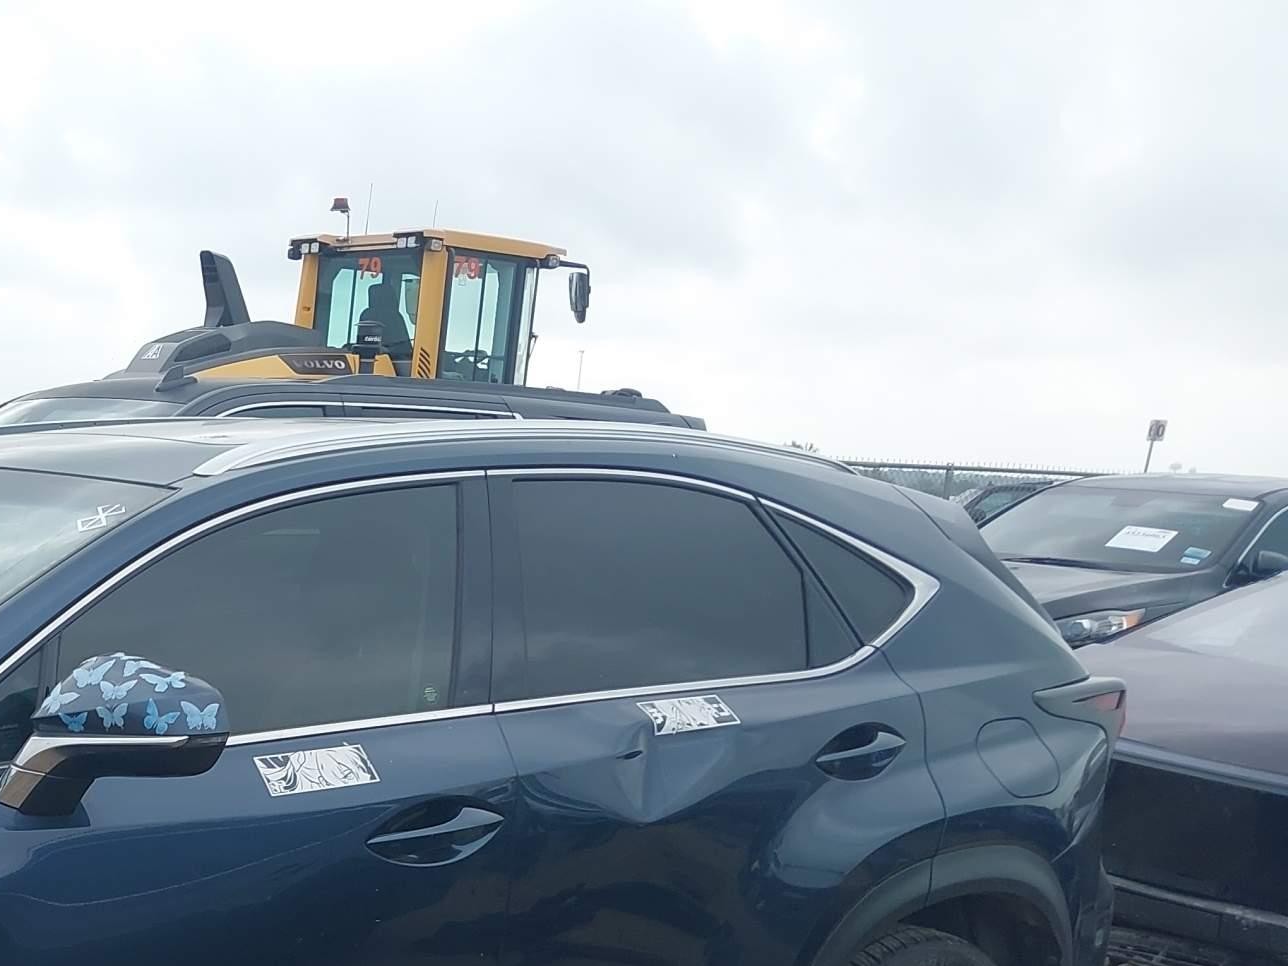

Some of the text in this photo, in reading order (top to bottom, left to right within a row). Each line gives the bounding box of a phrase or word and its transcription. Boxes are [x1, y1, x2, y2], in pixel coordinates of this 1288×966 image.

[359, 257, 381, 279] 79
[454, 256, 479, 279] 79
[292, 359, 345, 369] VOLVO
